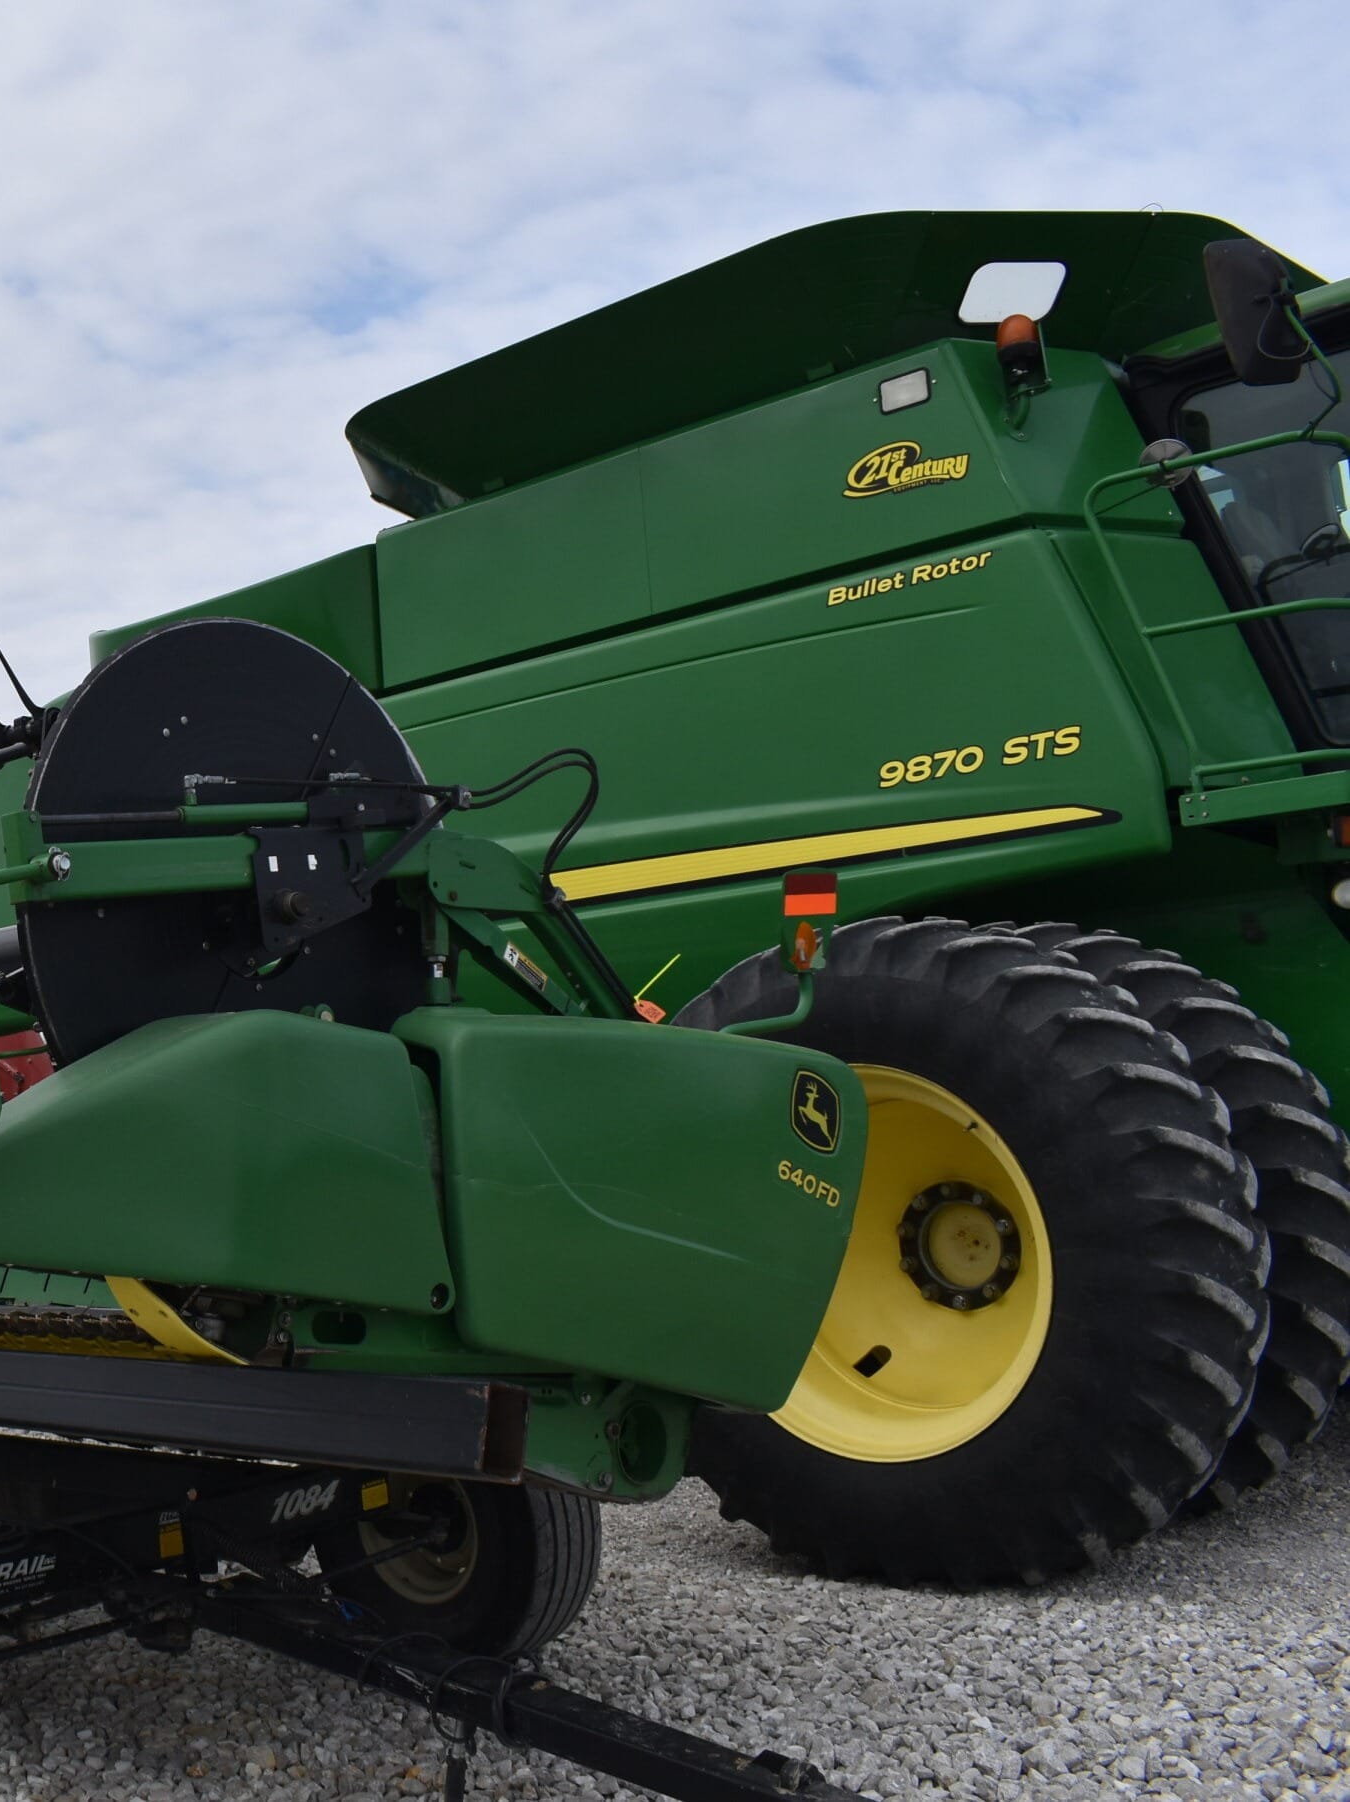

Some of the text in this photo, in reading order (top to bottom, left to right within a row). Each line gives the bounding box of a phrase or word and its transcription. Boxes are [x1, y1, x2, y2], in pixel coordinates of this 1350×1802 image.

[826, 550, 993, 607] Bullet Rotor
[878, 725, 1081, 788] 9870 STS
[777, 1159, 840, 1208] 640FD
[270, 1479, 340, 1524] 1084
